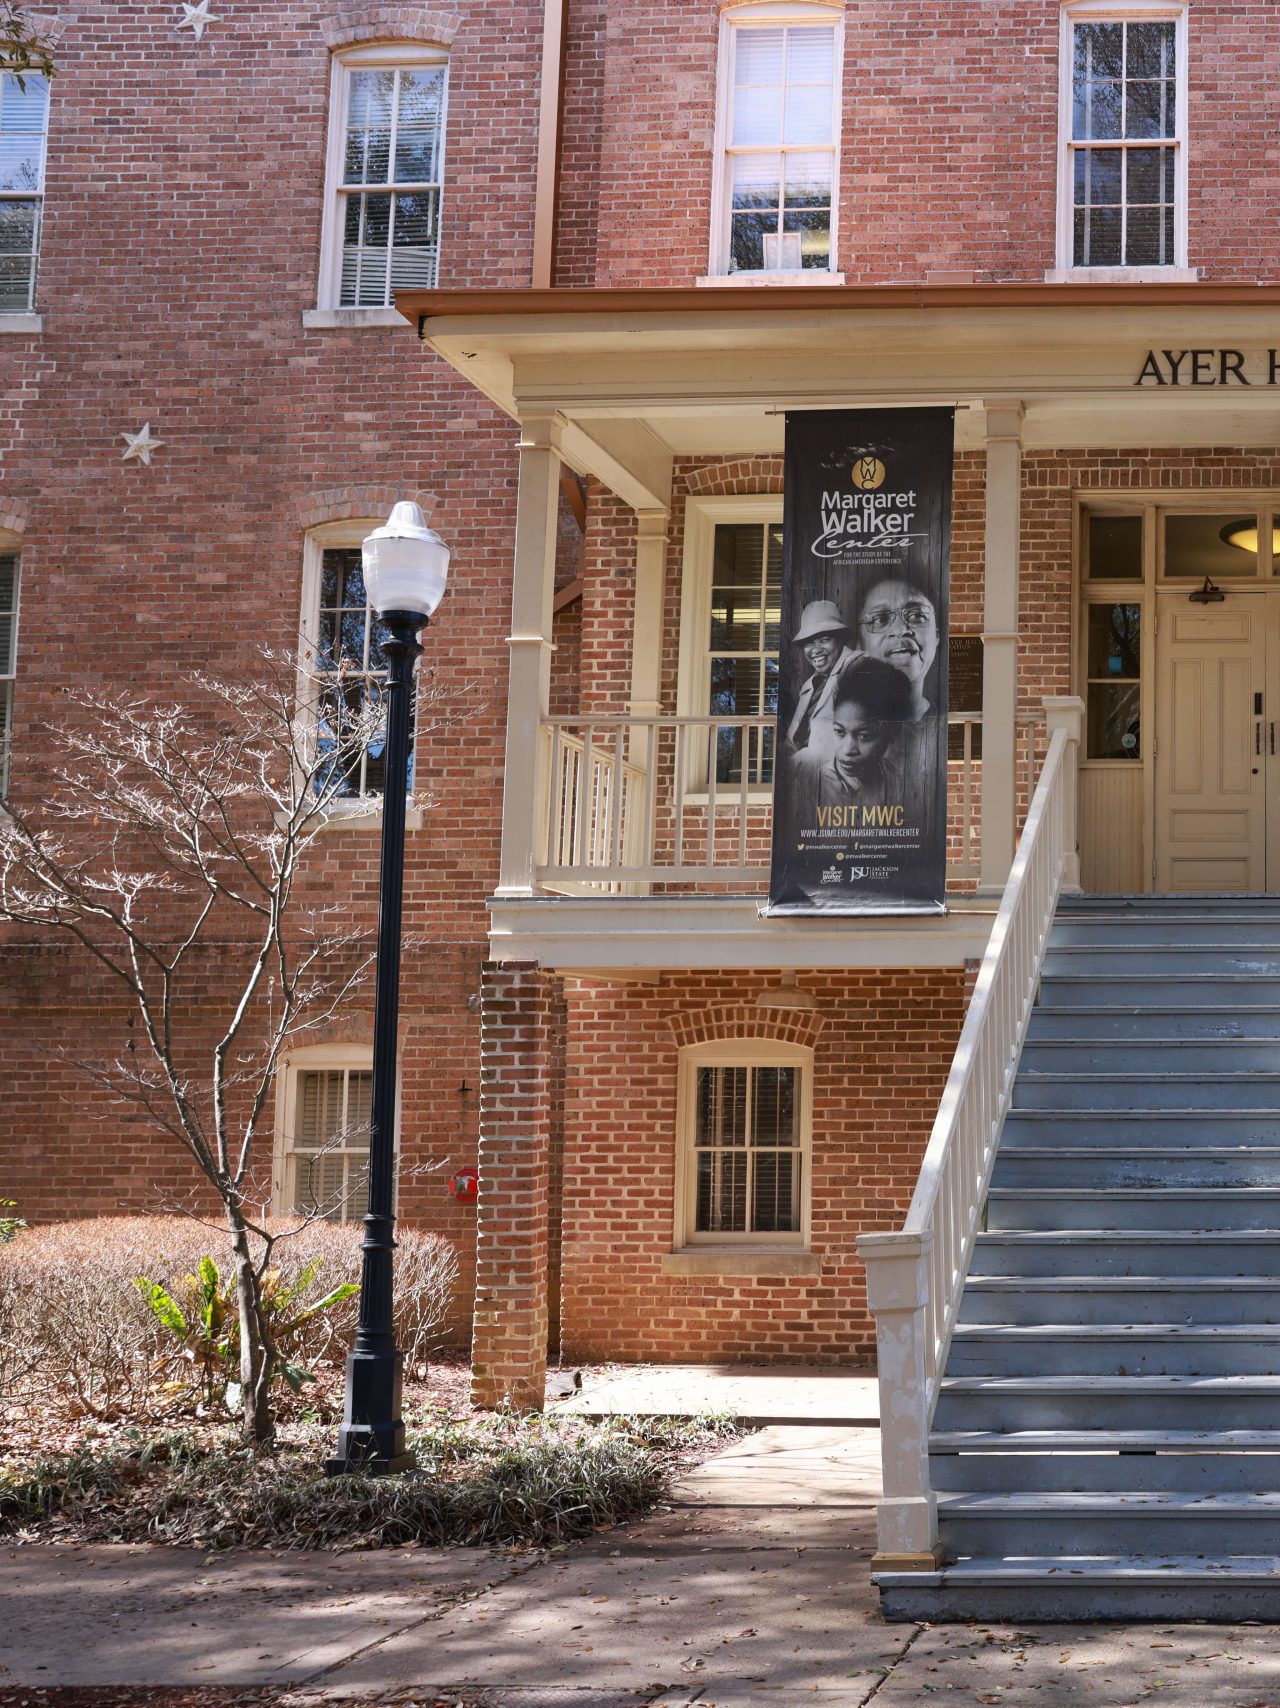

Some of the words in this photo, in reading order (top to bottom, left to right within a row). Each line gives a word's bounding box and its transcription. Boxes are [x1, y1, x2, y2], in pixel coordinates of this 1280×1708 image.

[1133, 349, 1252, 386] AYER
[821, 490, 917, 512] Margaret
[820, 508, 915, 534] Walker
[810, 529, 929, 558] Center
[816, 806, 858, 827] VISIT
[862, 805, 904, 827] MWC
[800, 828, 920, 838] WWW.JSUMS.EDU/MARGARETWALKERCENTER
[849, 866, 870, 882] JSU
